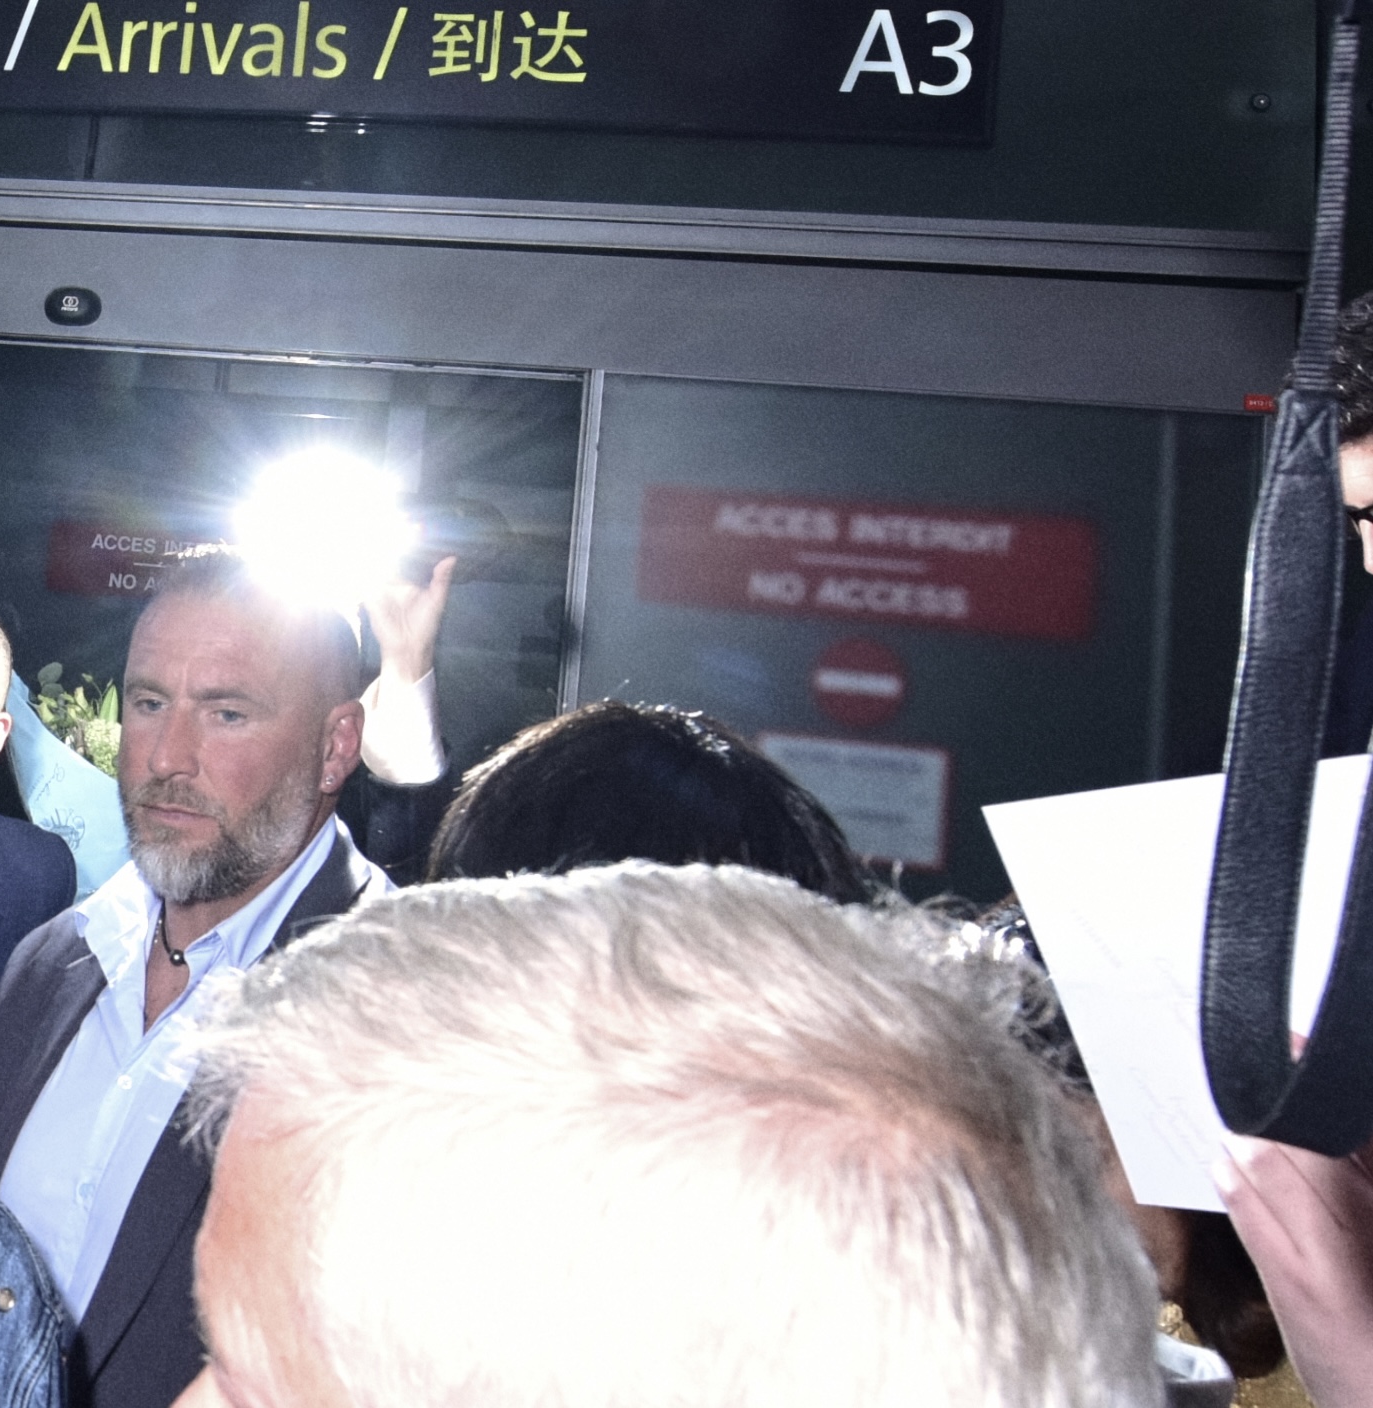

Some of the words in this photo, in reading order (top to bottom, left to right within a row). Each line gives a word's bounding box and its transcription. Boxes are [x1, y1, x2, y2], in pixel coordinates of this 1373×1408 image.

[57, 1, 347, 79] Arrivals
[428, 10, 588, 83] 到达
[839, 9, 974, 96] A3
[91, 533, 157, 554] ACCES
[714, 503, 839, 542] ACCES
[108, 572, 137, 590] NO
[748, 571, 806, 606] NO
[815, 577, 970, 619] ACCESS
